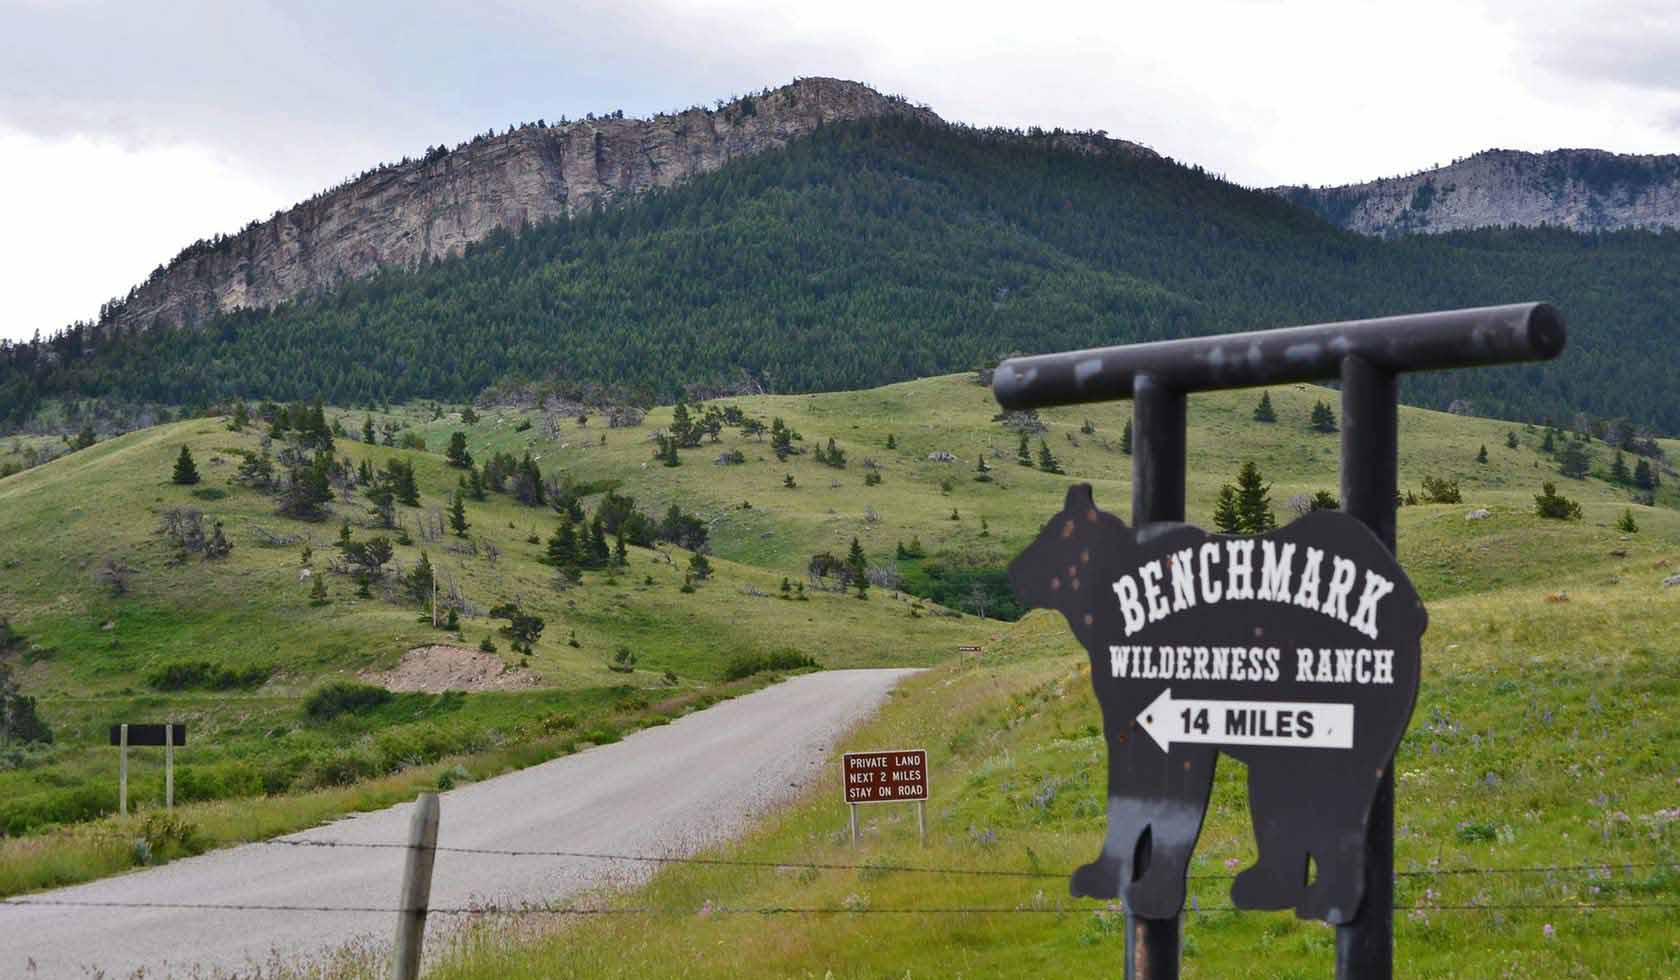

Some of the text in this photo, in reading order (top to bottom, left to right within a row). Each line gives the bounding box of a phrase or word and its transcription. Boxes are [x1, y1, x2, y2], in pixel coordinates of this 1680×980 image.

[1112, 539, 1394, 640] BENCHMARK
[1109, 645, 1394, 684] WILDERNESS RANCH
[1180, 707, 1314, 738] 14 MILES
[850, 755, 921, 768] PRIVATE LAND
[849, 770, 921, 783] NEXT 2 MILES
[849, 785, 923, 798] STAY ON ROAD
